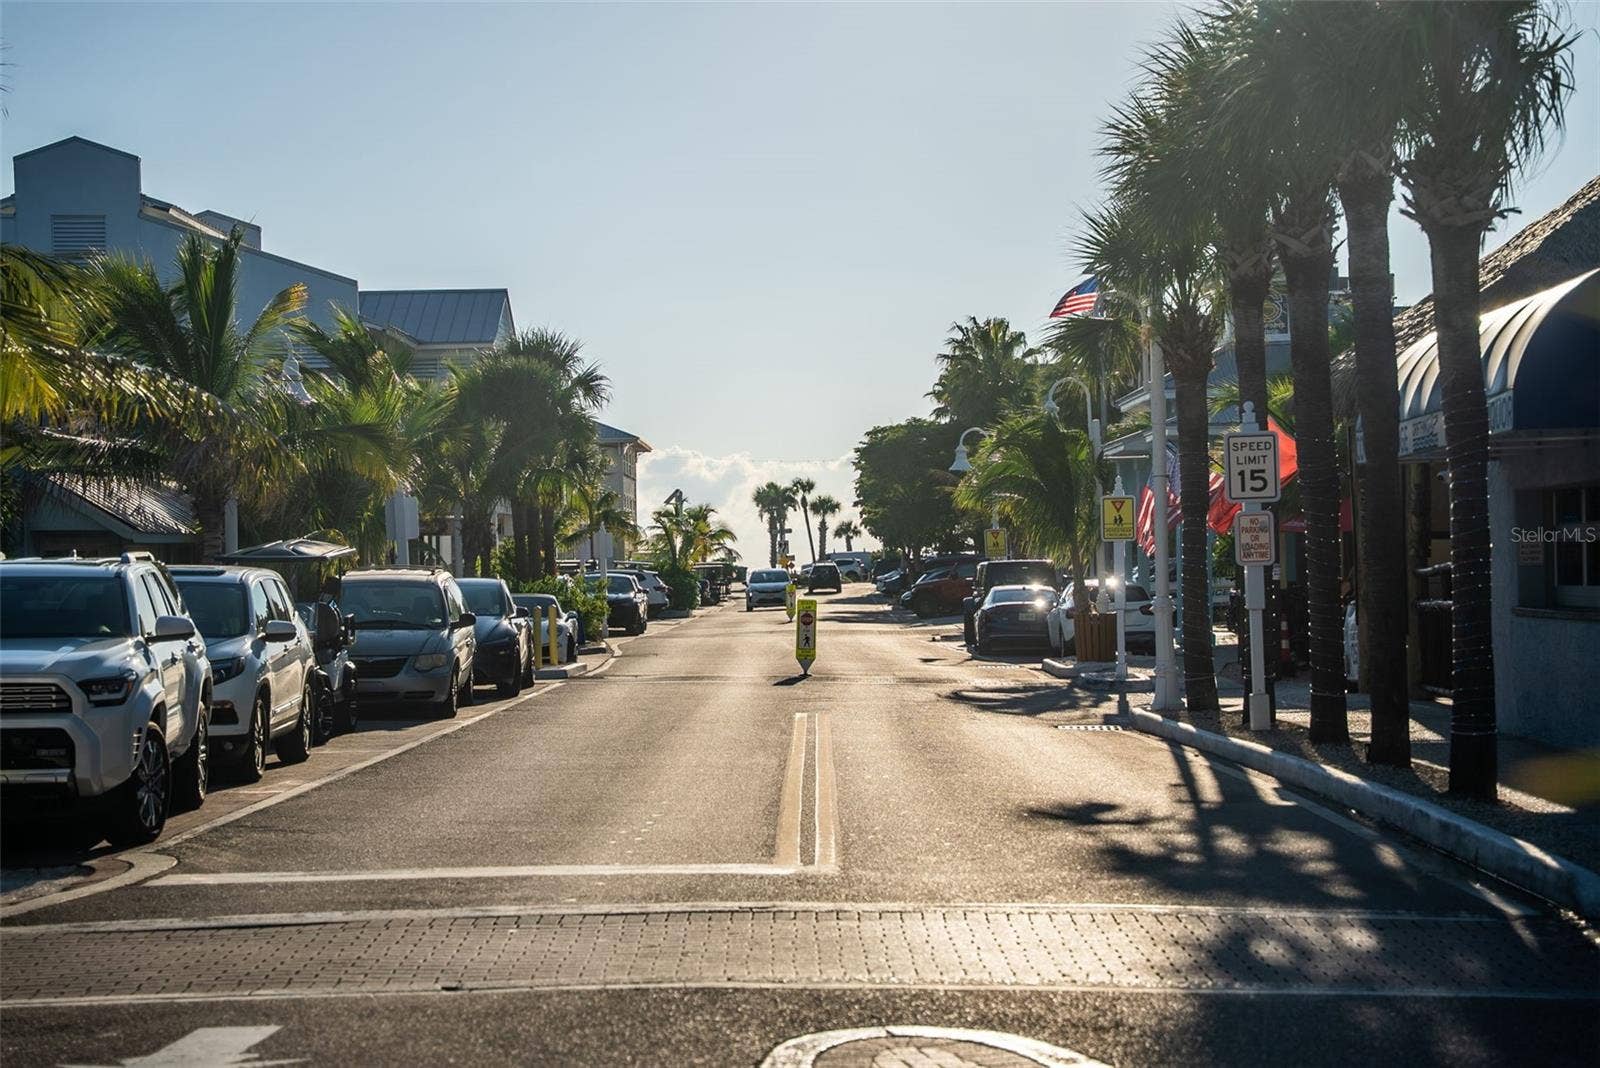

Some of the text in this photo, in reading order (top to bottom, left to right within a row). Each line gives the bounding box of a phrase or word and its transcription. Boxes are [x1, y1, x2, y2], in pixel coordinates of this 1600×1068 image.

[1232, 441, 1272, 452] SPEED
[1236, 455, 1268, 465] LIMIT
[1237, 469, 1268, 493] 15
[1249, 518, 1259, 526] NO
[1241, 526, 1268, 534] PARKING
[1241, 543, 1268, 551] LOADING
[1242, 551, 1269, 559] ANYTIME
